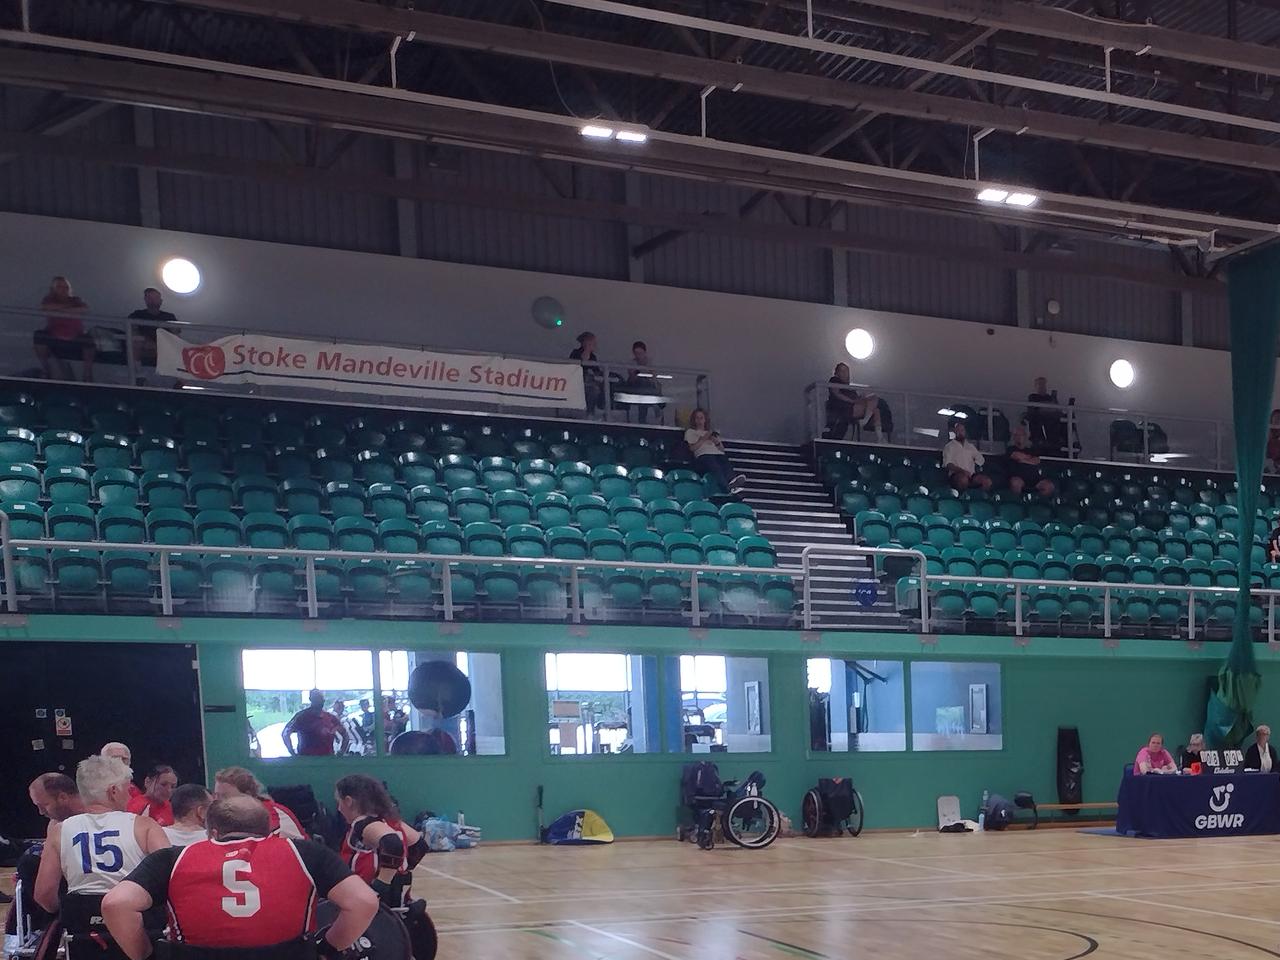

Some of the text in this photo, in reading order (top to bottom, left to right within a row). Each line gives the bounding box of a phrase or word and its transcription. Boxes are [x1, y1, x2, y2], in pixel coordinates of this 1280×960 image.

[232, 344, 568, 392] Stoke Mandeville Stadium
[1194, 813, 1245, 830] GBWR
[72, 829, 124, 874] 15
[221, 858, 261, 918] 5
